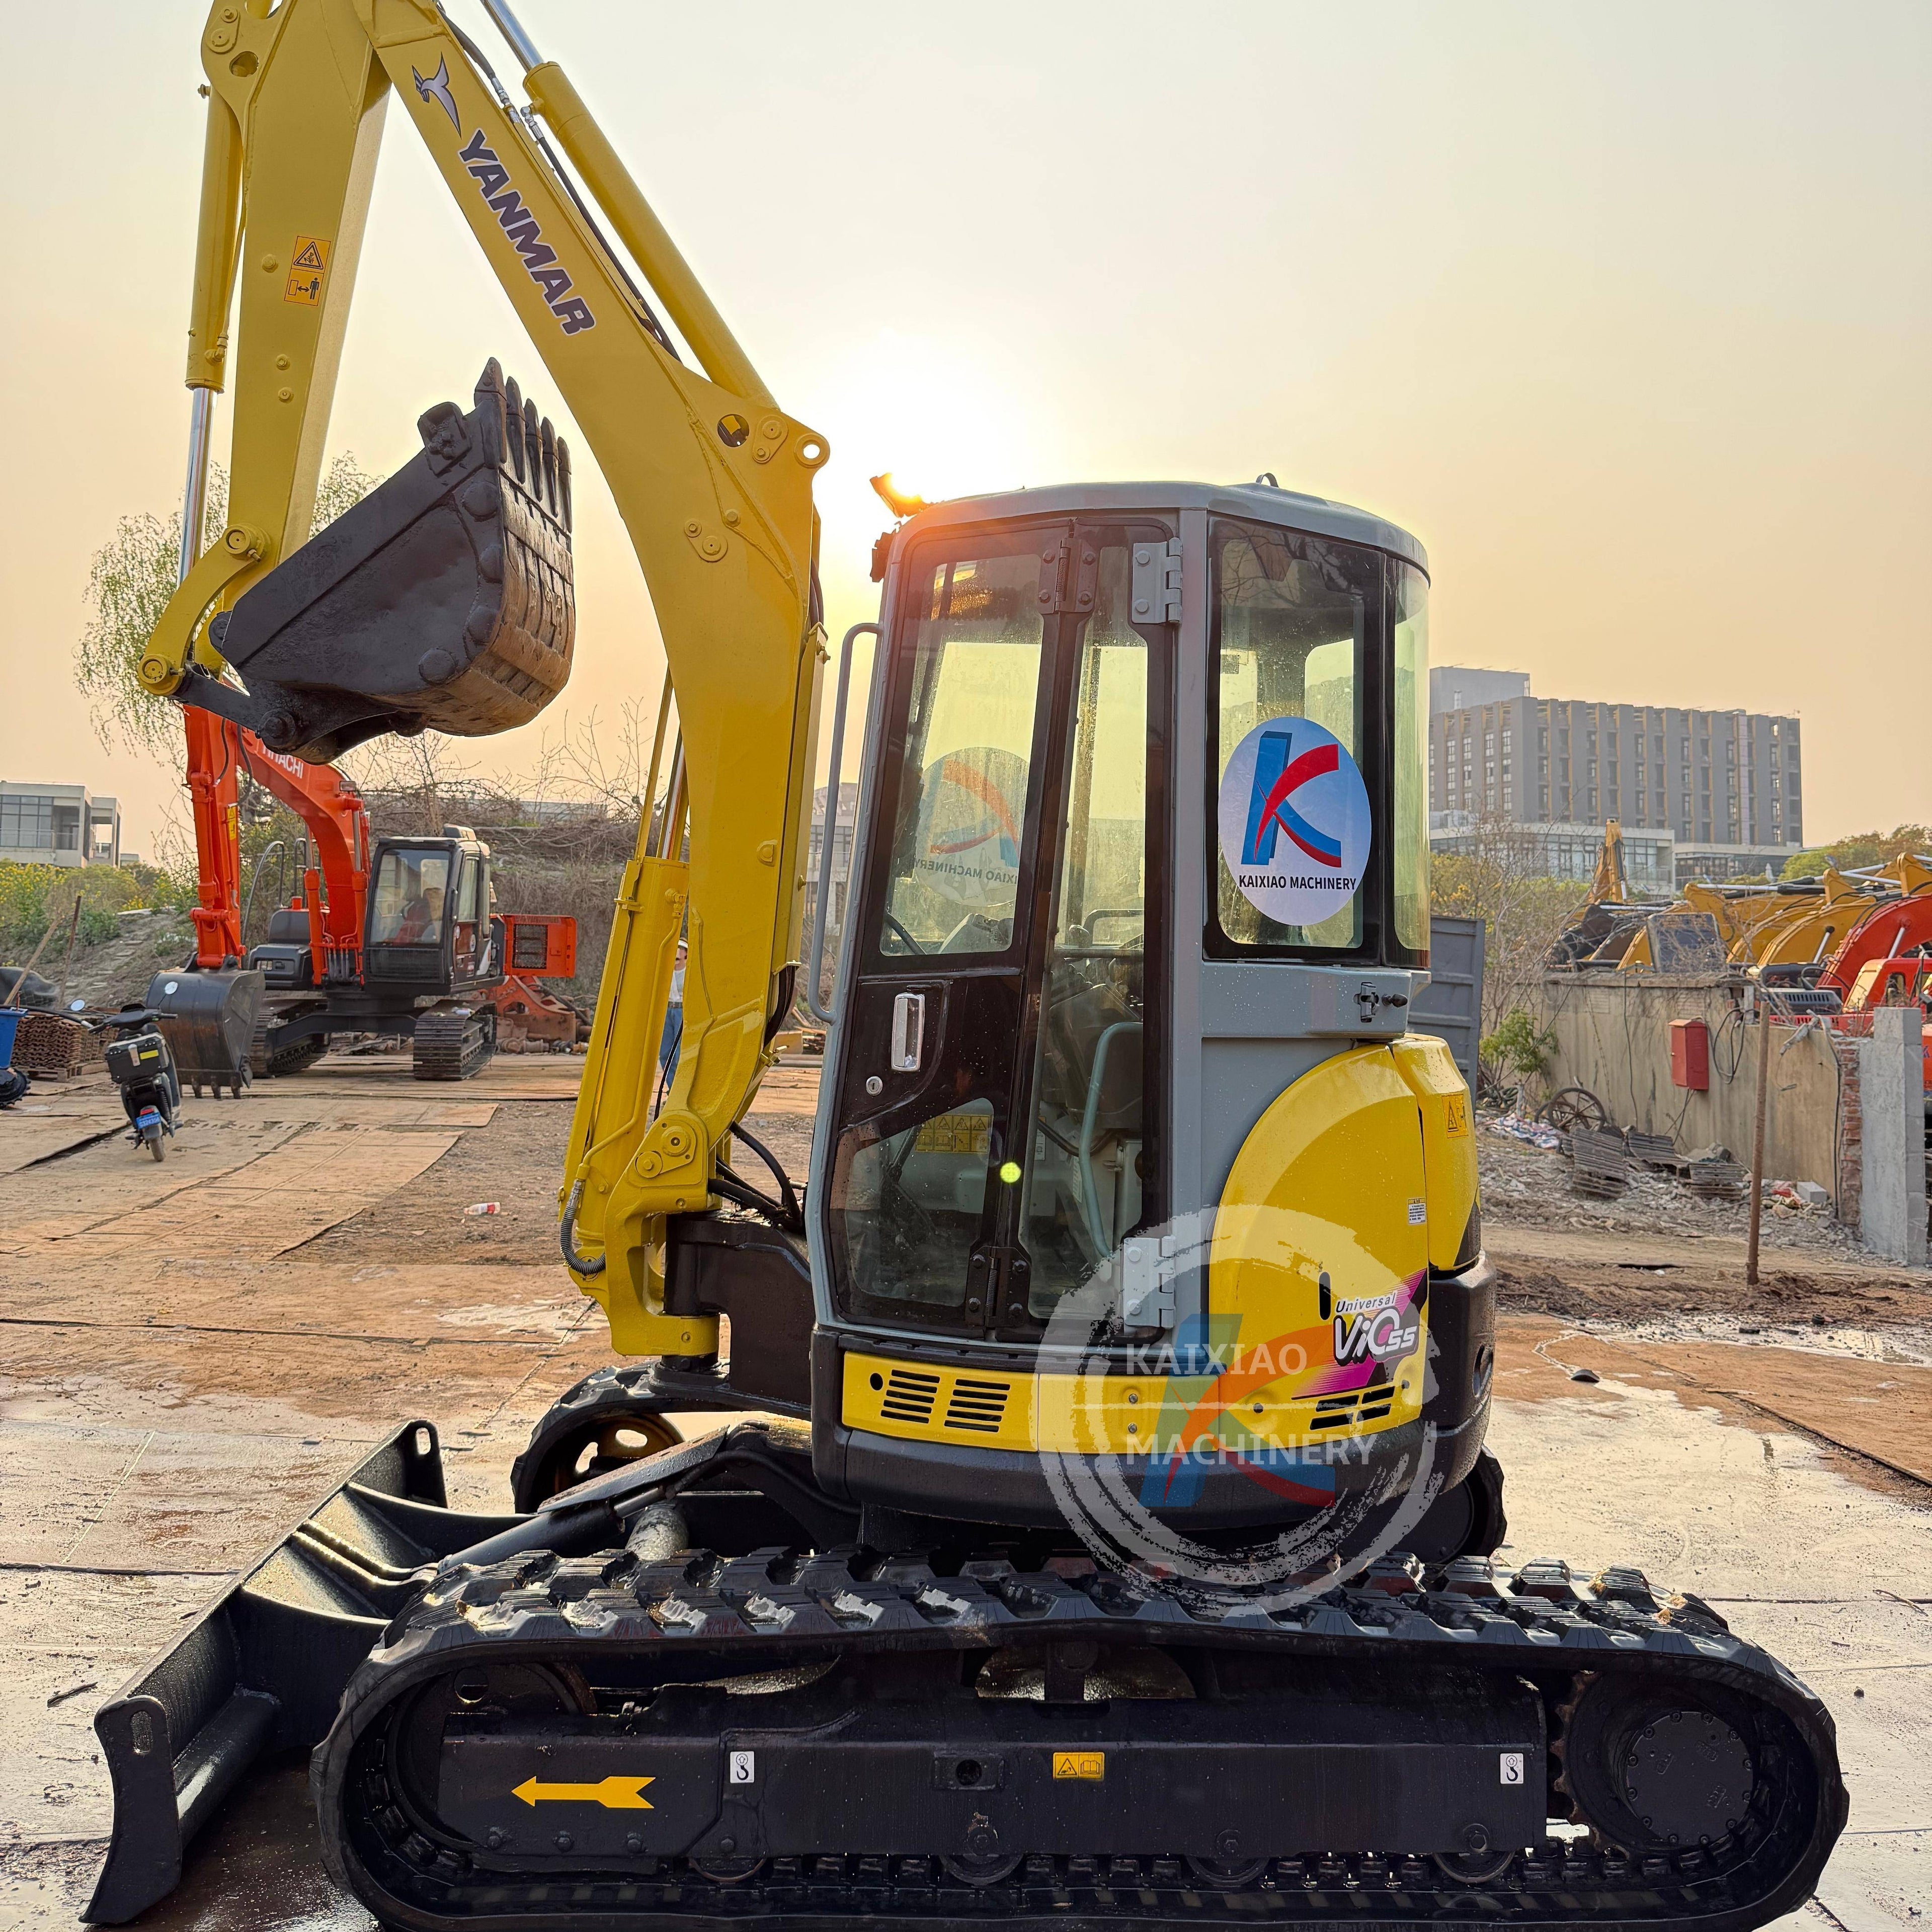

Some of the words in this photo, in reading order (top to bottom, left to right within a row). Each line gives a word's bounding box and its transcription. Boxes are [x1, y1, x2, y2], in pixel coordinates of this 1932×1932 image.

[458, 128, 595, 336] YANMAR
[1239, 874, 1286, 889] KAIXIAO
[1290, 876, 1356, 890] MACHINERY
[1336, 1293, 1395, 1313] Universal
